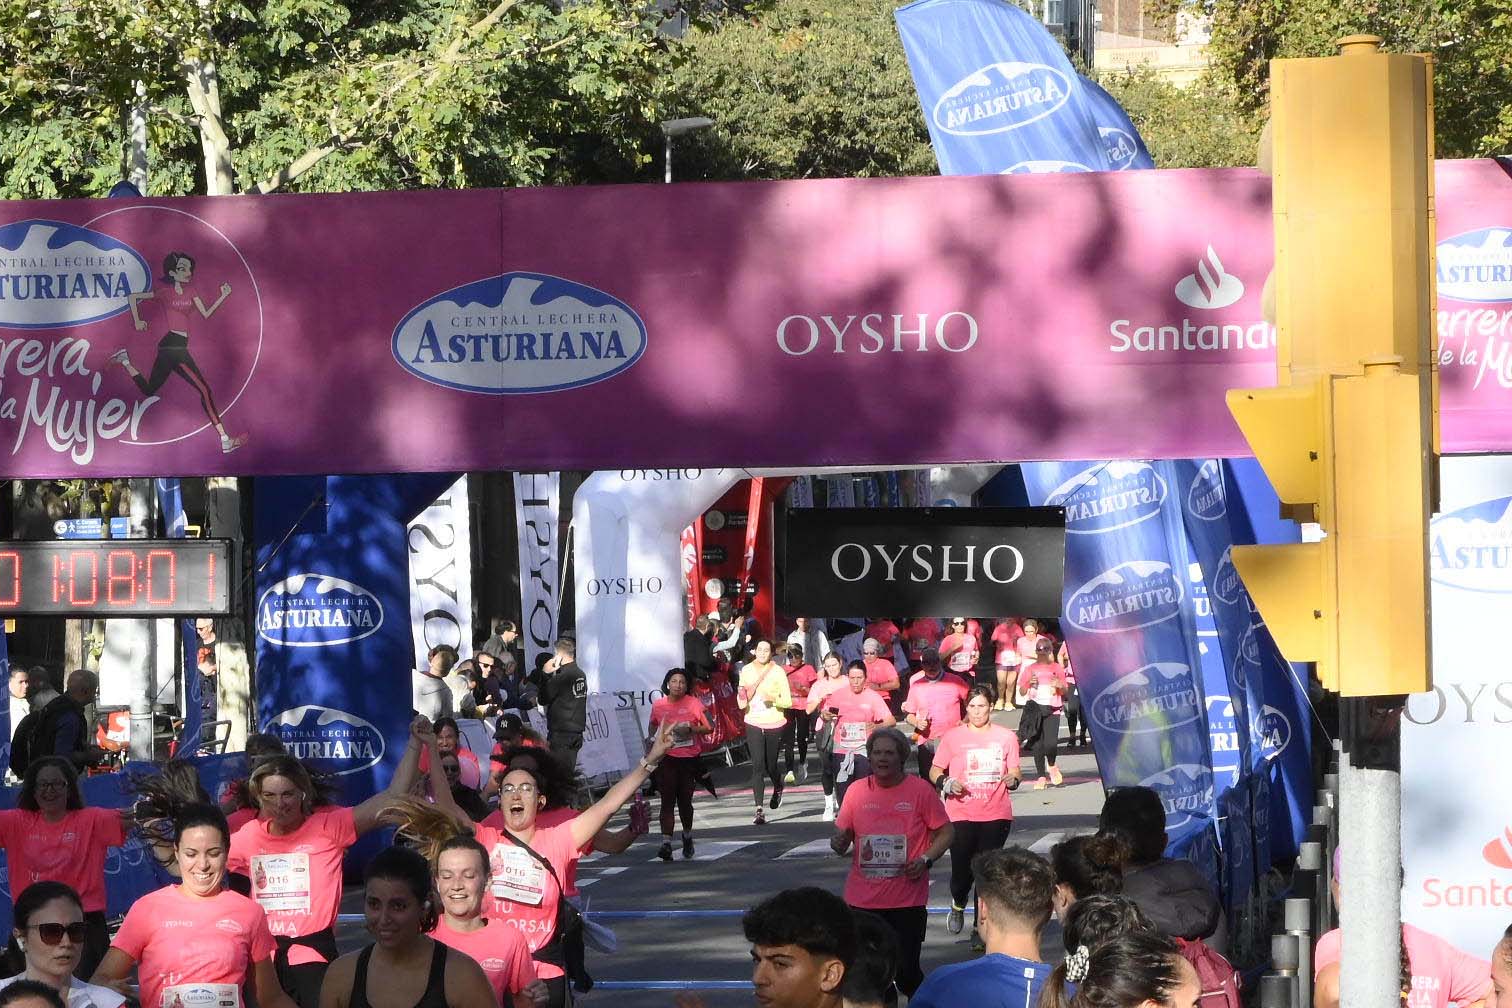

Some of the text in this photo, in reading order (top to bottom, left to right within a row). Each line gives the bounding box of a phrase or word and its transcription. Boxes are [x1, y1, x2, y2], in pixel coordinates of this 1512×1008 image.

[53, 255, 126, 268] LECHERA
[450, 312, 618, 328] CENTRAL LECHERA
[412, 319, 627, 364] ASTURIANA
[776, 311, 979, 356] OYSHO
[1110, 319, 1276, 352] Santand
[1459, 338, 1479, 366] la
[12, 373, 161, 466] Mujer
[830, 543, 1025, 584] OYSHO
[586, 576, 663, 597] OYSHO
[273, 598, 316, 607] CENTRAL
[261, 601, 374, 632] ASTURIANA
[281, 738, 374, 760] TURIANA
[874, 850, 891, 858] 016
[268, 875, 289, 884] 016
[505, 866, 526, 877] 016
[493, 901, 513, 914] TU
